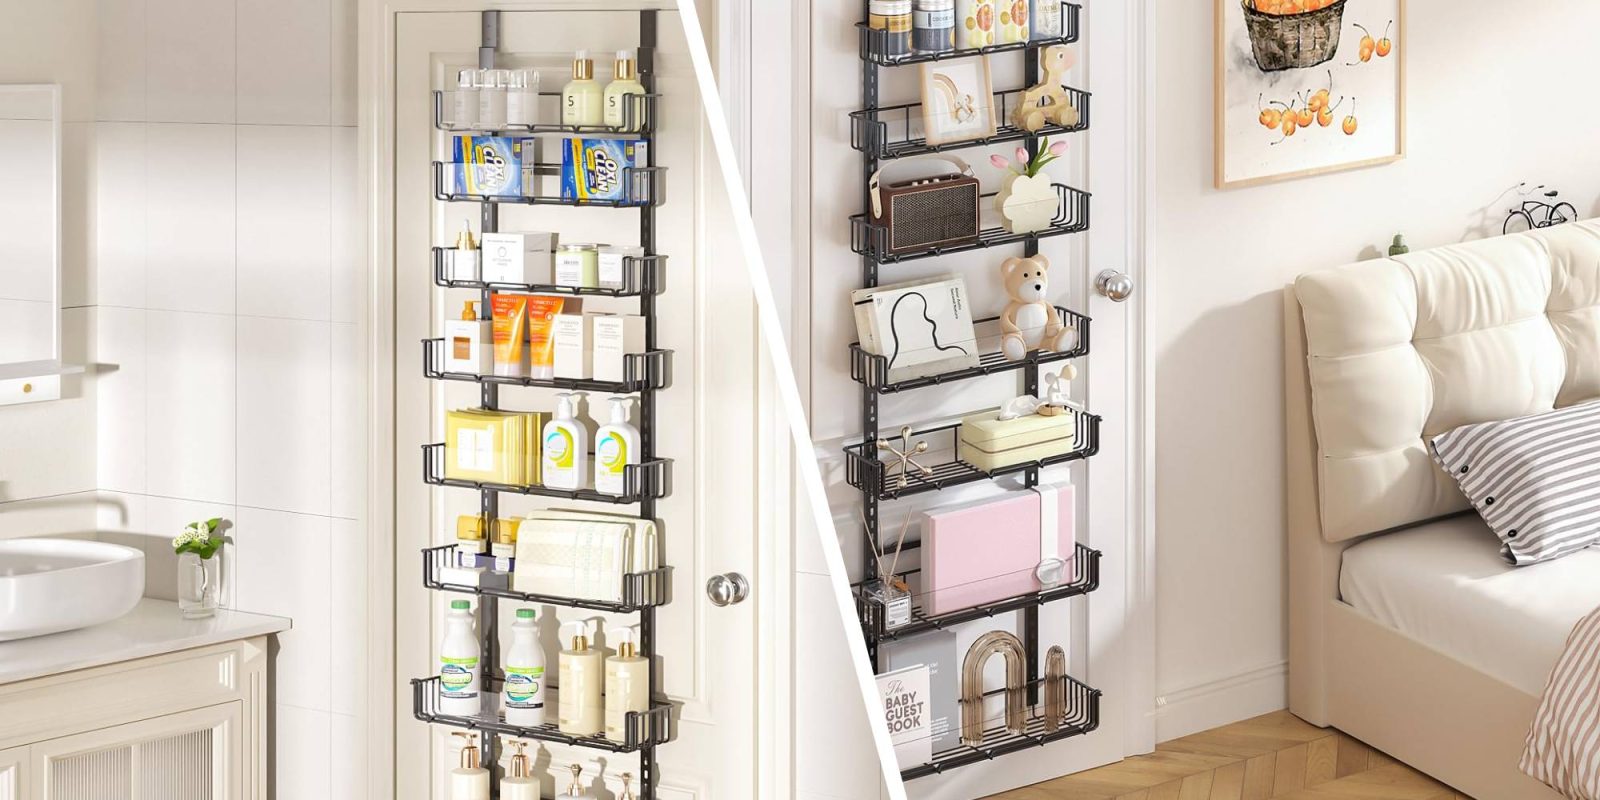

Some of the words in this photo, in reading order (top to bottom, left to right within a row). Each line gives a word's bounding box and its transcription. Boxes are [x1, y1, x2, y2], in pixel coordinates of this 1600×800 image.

[568, 95, 574, 107] S
[609, 96, 616, 107] S
[493, 156, 506, 181] OXI
[594, 149, 609, 192] CLEAN
[605, 159, 618, 184] OXI
[886, 679, 904, 696] The
[886, 691, 916, 710] BABY
[886, 701, 924, 722] GUEST
[887, 715, 920, 734] BOOK
